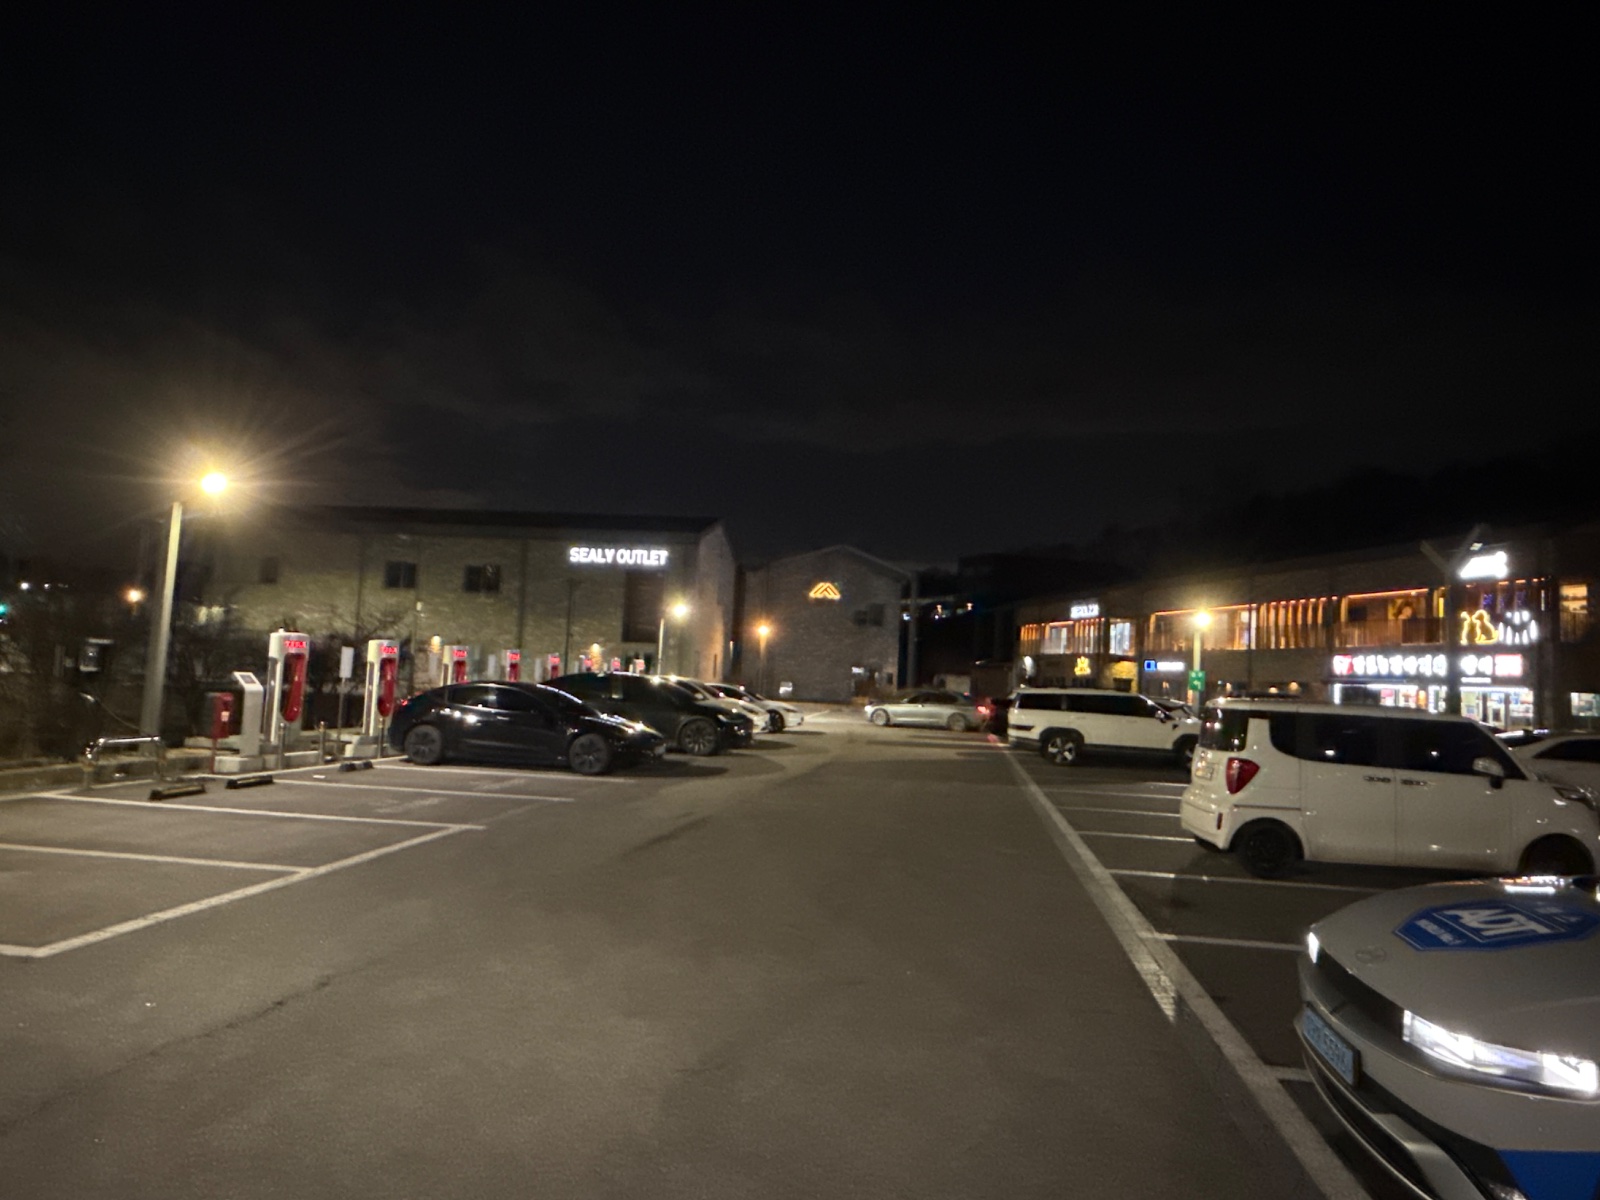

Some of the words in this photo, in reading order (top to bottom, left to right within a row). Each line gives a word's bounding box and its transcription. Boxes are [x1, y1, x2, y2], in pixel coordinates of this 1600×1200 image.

[569, 547, 615, 563] SEALY
[616, 549, 668, 566] OUTLET
[1442, 908, 1555, 937] ADT
